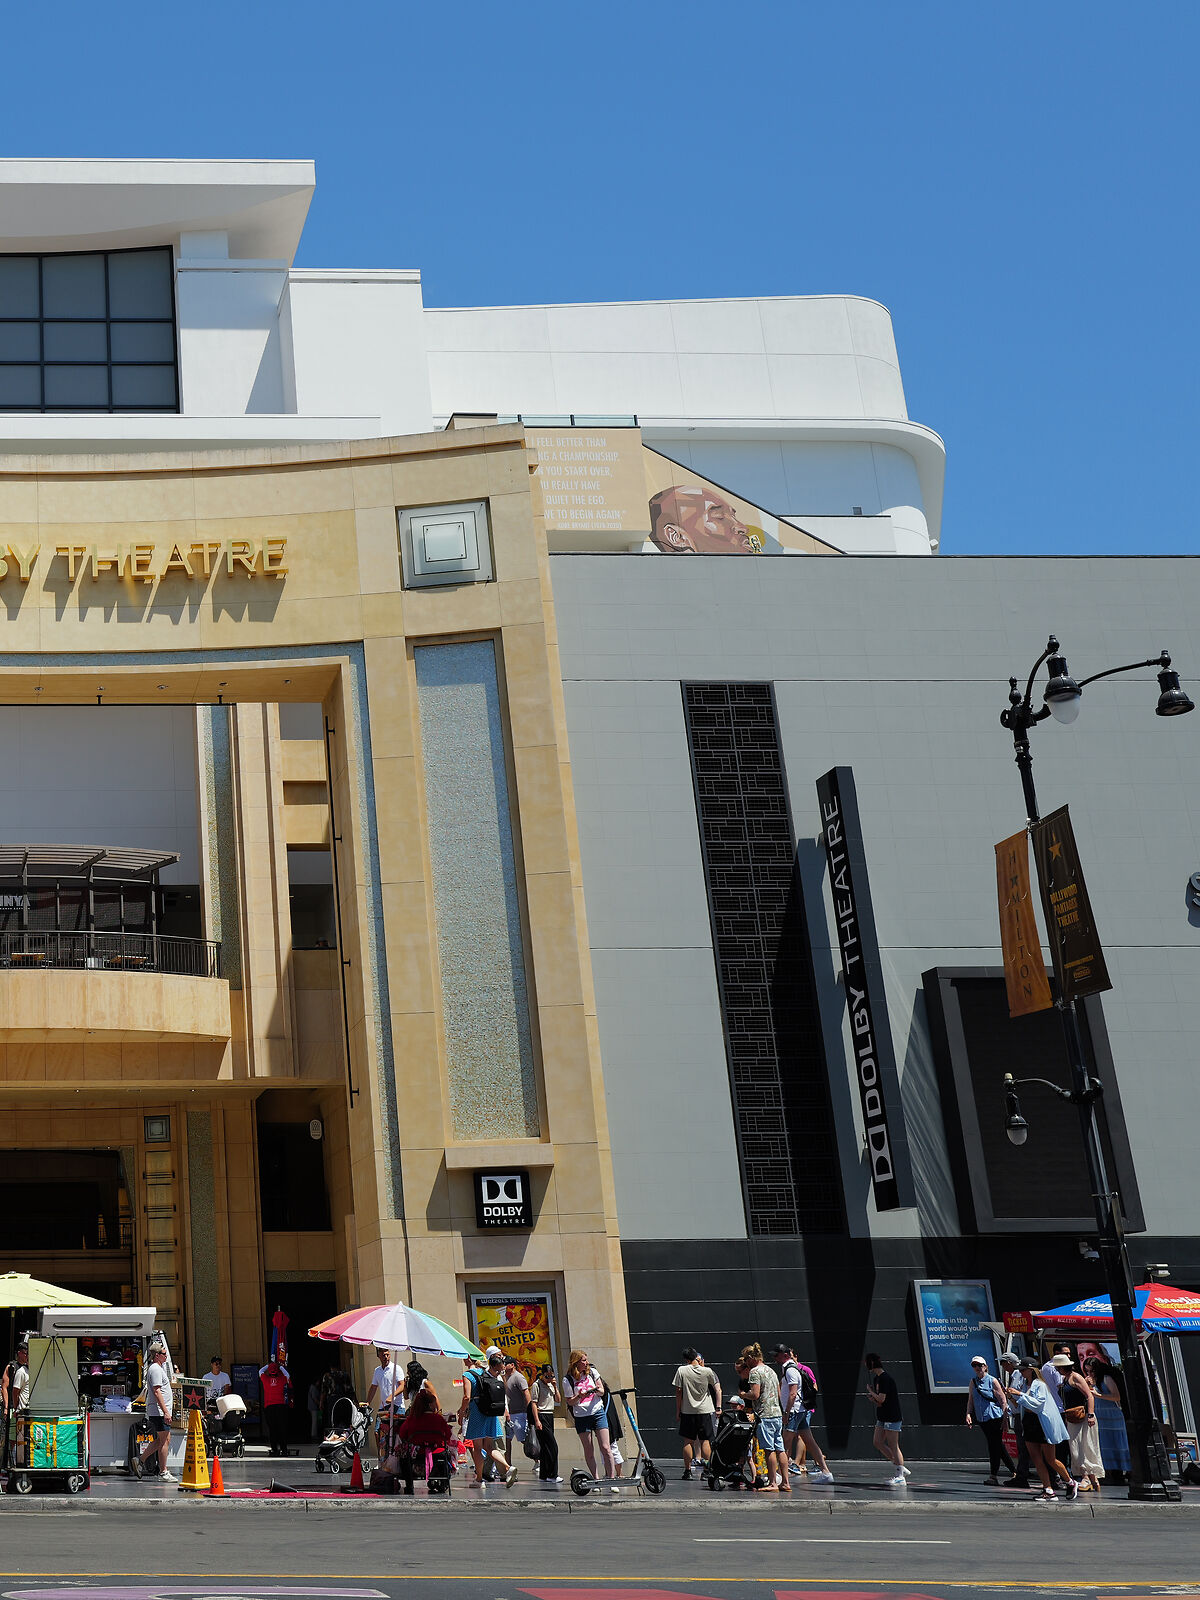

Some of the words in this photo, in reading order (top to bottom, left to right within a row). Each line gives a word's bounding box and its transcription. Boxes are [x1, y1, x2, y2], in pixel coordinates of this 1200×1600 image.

[556, 437, 584, 447] BETTER
[586, 437, 607, 447] THAN
[552, 451, 558, 461] A
[546, 466, 562, 476] YOU
[565, 466, 588, 476] START
[551, 480, 579, 490] REALLY
[581, 480, 601, 490] HAVE
[546, 495, 569, 505] QUIET
[571, 495, 586, 505] THE
[558, 510, 568, 520] TO
[570, 510, 594, 520] BEGIN
[55, 536, 290, 582] THEATRE
[823, 795, 860, 975] THEATRE
[850, 986, 882, 1118] DOLBY
[483, 1206, 523, 1217] DOLBY
[499, 1326, 514, 1335] GET
[492, 1332, 536, 1348] TWISTED
[929, 1333, 950, 1341] pause
